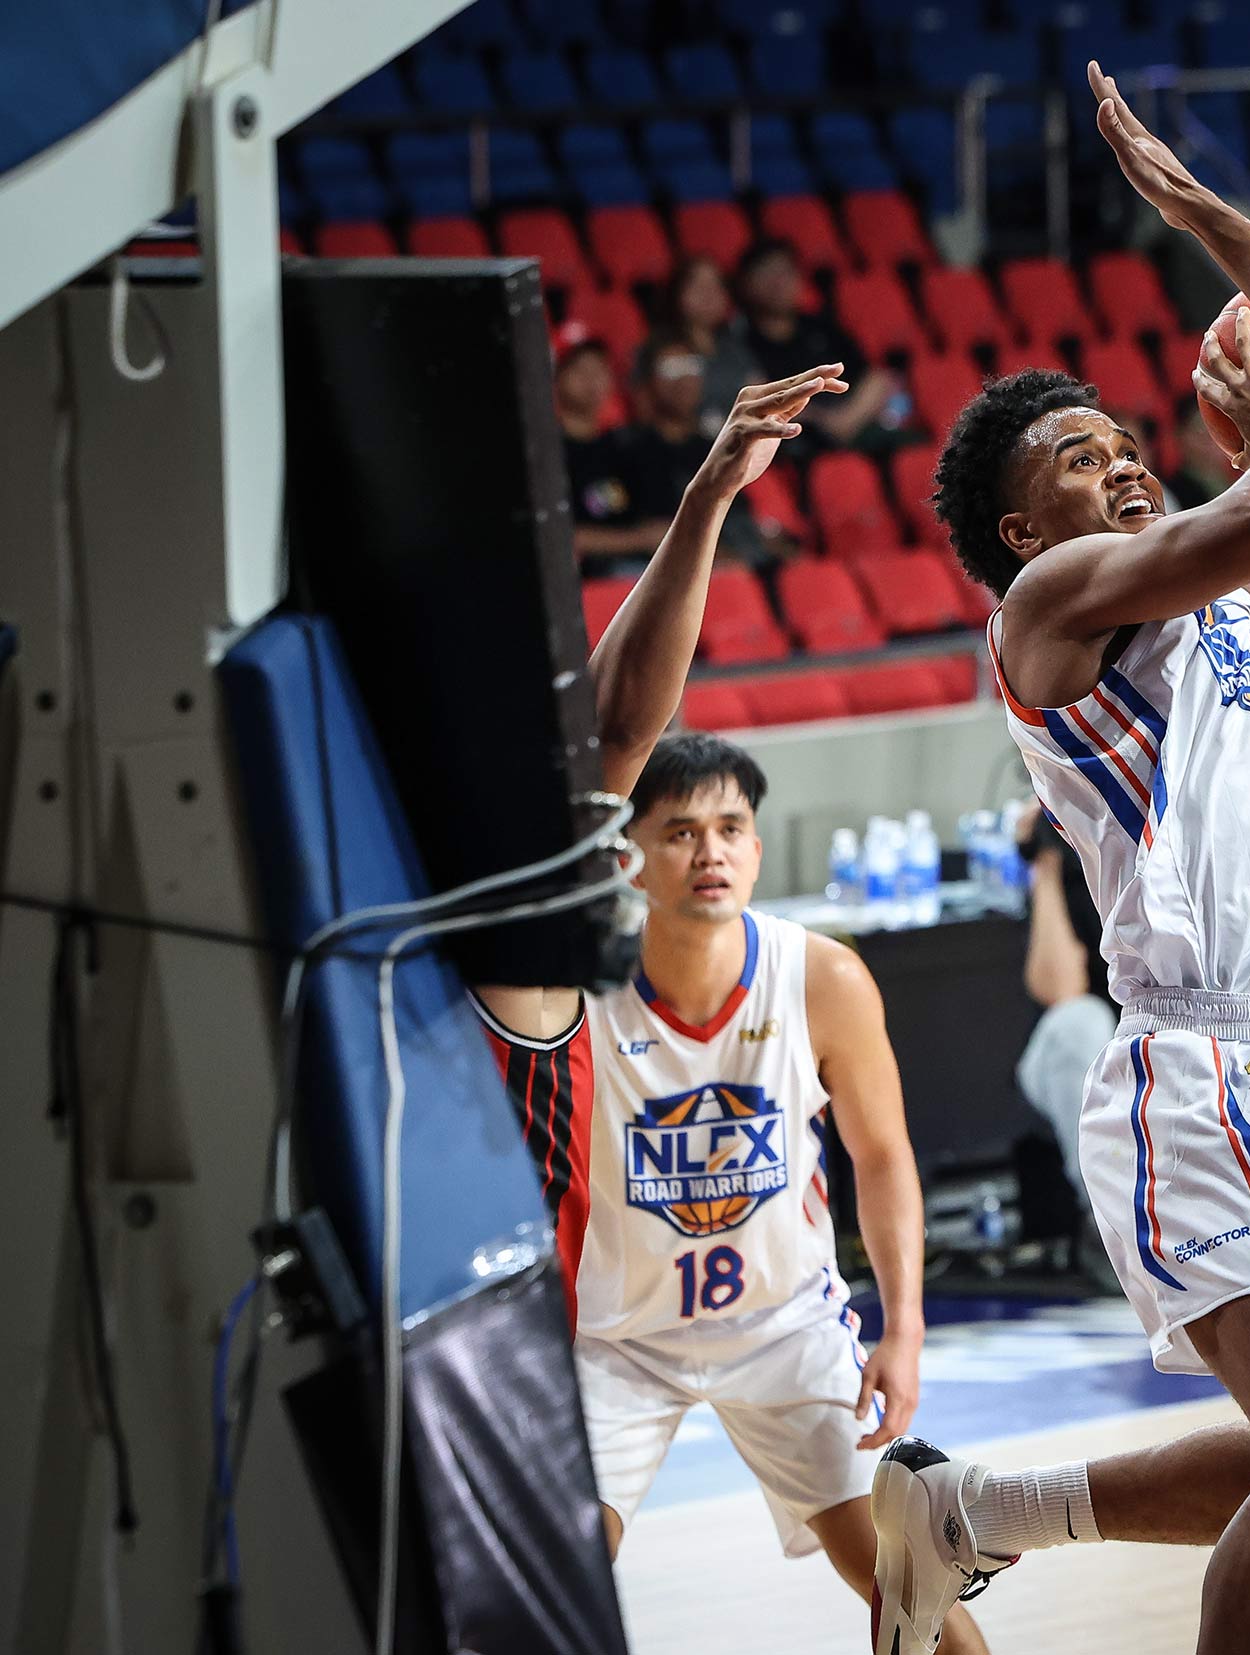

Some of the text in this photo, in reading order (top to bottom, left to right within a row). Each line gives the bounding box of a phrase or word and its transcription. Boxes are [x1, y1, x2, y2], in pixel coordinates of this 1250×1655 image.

[633, 1119, 778, 1174] NLEX
[629, 1166, 786, 1202] ROAD WARRIORS
[1174, 1237, 1198, 1254] NLEX
[1175, 1226, 1250, 1264] CONNECTOR
[674, 1244, 744, 1318] 18
